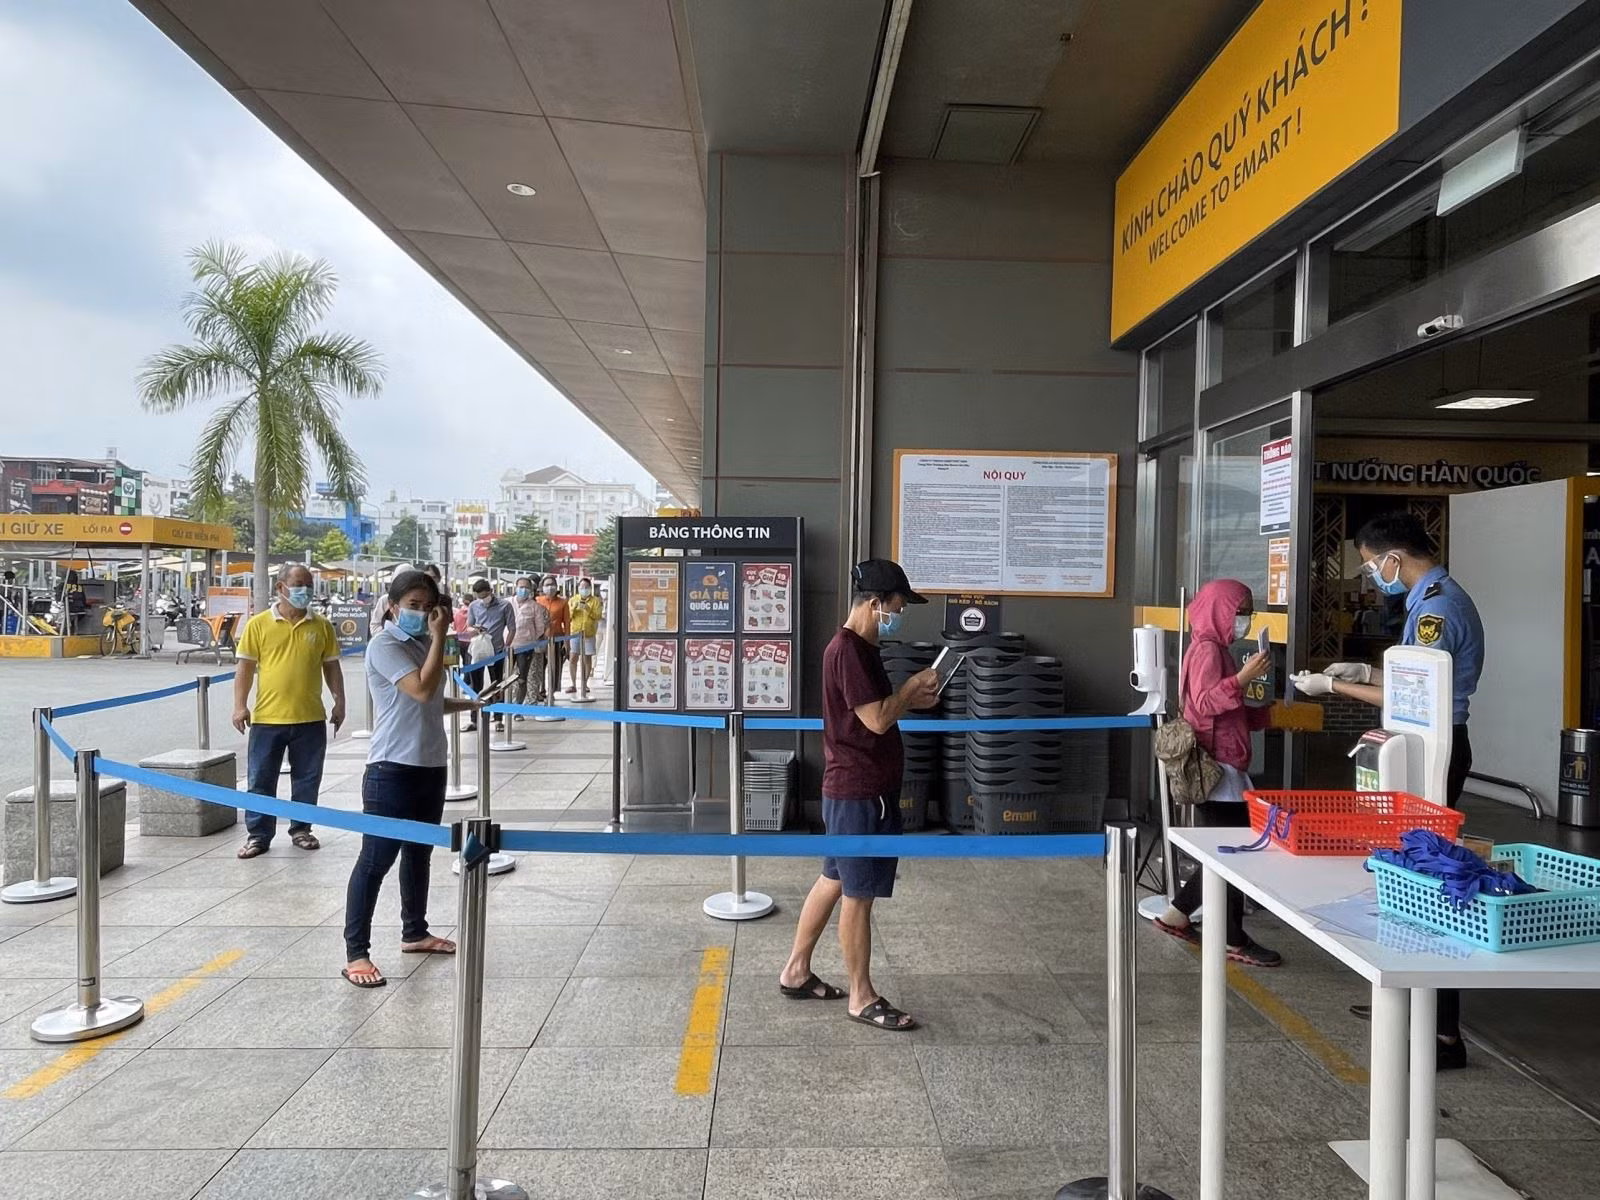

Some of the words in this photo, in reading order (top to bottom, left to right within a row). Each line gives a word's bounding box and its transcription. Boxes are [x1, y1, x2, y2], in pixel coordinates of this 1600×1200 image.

[1157, 152, 1204, 217] CHÀO
[1208, 92, 1251, 170] QUÝ
[1256, 0, 1350, 123] KHÁCH
[1148, 195, 1207, 264] WELCOME
[1210, 175, 1229, 210] TO
[1233, 115, 1293, 191] EMART
[1295, 106, 1302, 135] !
[983, 470, 1002, 482] NỘI
[1004, 471, 1027, 481] QUY
[1332, 457, 1415, 482] NƯỚNG
[1420, 459, 1469, 483] HÀN
[1476, 460, 1542, 485] QUỐC
[10, 519, 40, 535] GIỮ
[43, 523, 64, 535] XE
[82, 521, 99, 534] LỐI
[101, 525, 114, 534] RA
[649, 523, 689, 539] BẢNG
[692, 523, 744, 539] THÔNG
[748, 526, 771, 539] TIN
[689, 588, 710, 600] GIÁ
[713, 587, 729, 600] RẺ
[690, 600, 711, 611] QUỐC
[712, 600, 729, 611] DÂN
